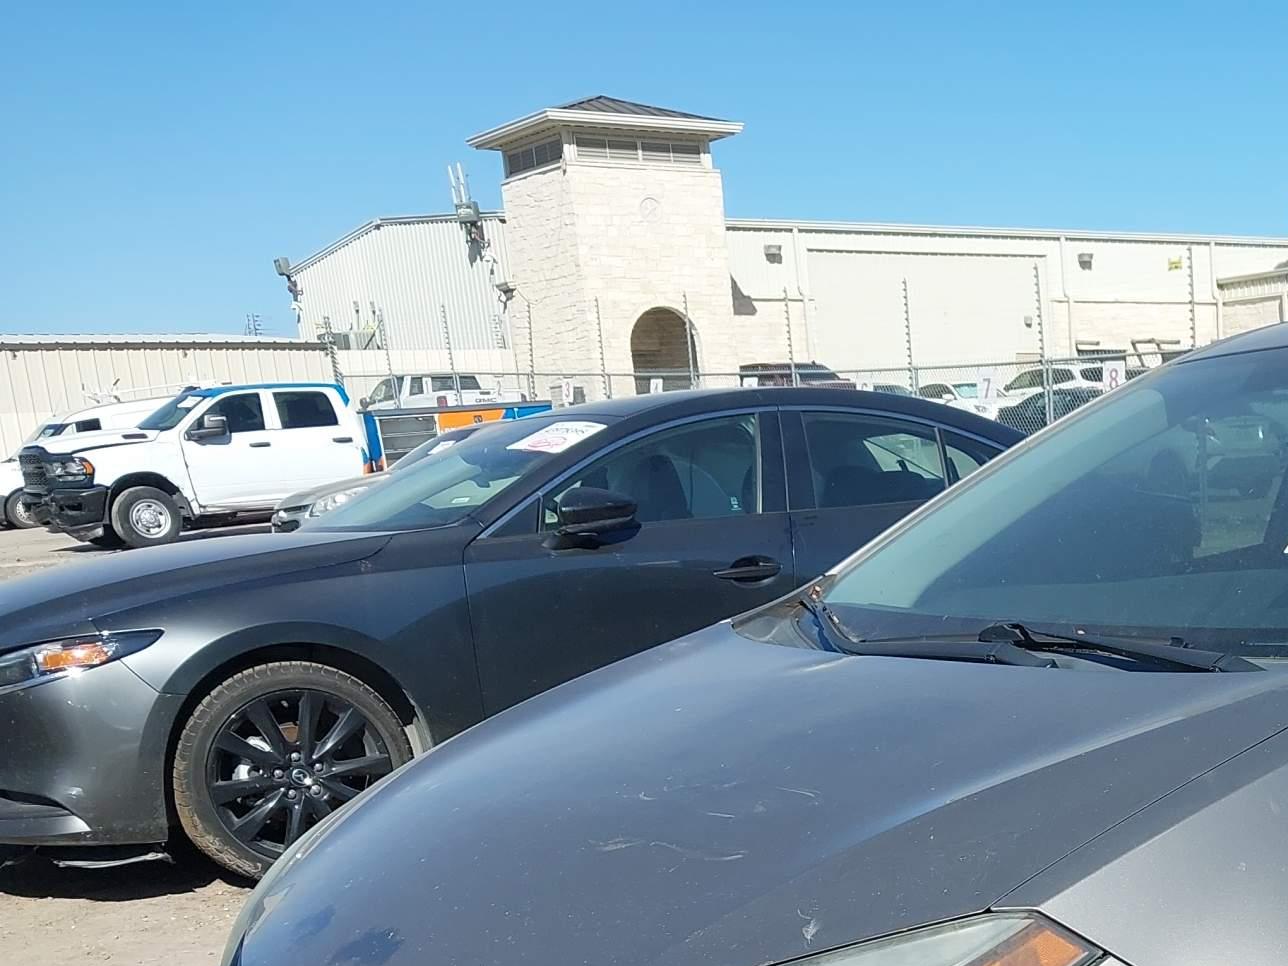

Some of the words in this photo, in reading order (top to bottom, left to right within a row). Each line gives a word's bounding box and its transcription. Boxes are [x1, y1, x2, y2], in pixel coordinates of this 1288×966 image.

[565, 381, 571, 399] 3
[982, 377, 991, 399] 7
[1109, 368, 1119, 390] 8
